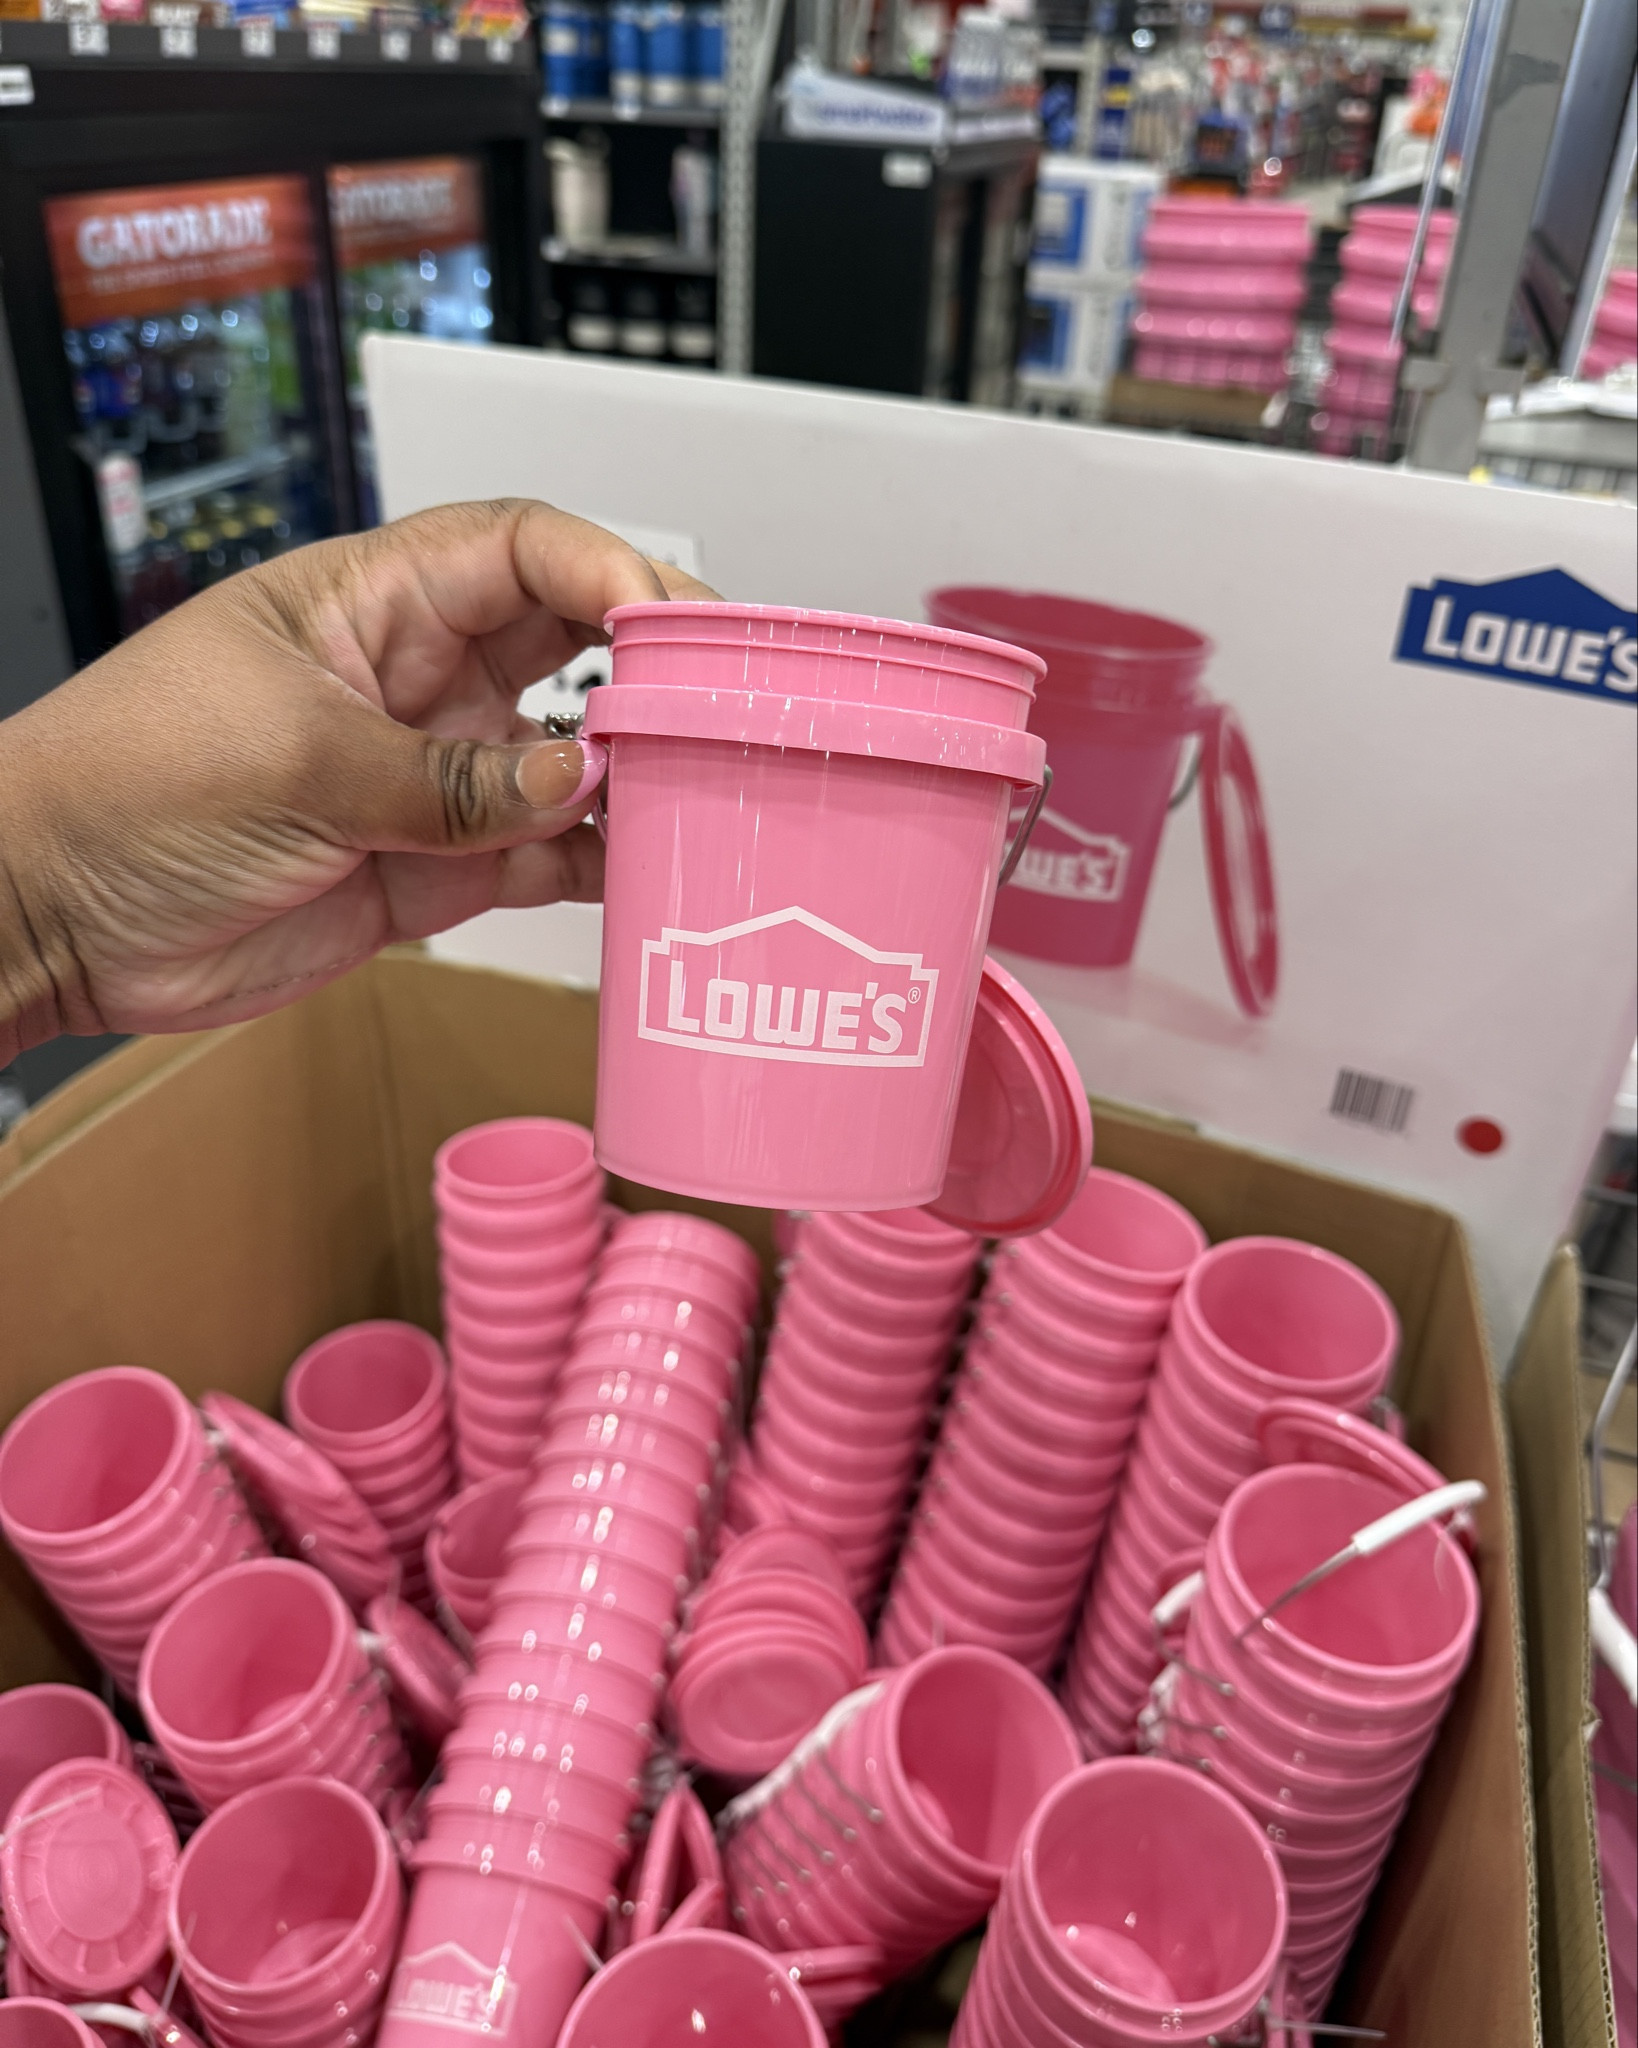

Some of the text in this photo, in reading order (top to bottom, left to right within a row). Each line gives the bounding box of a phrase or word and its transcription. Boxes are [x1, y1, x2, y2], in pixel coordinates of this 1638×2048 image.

[76, 196, 272, 269] GATORADE
[1422, 596, 1637, 693] LOWE'S
[1001, 845, 1109, 893] WE'S
